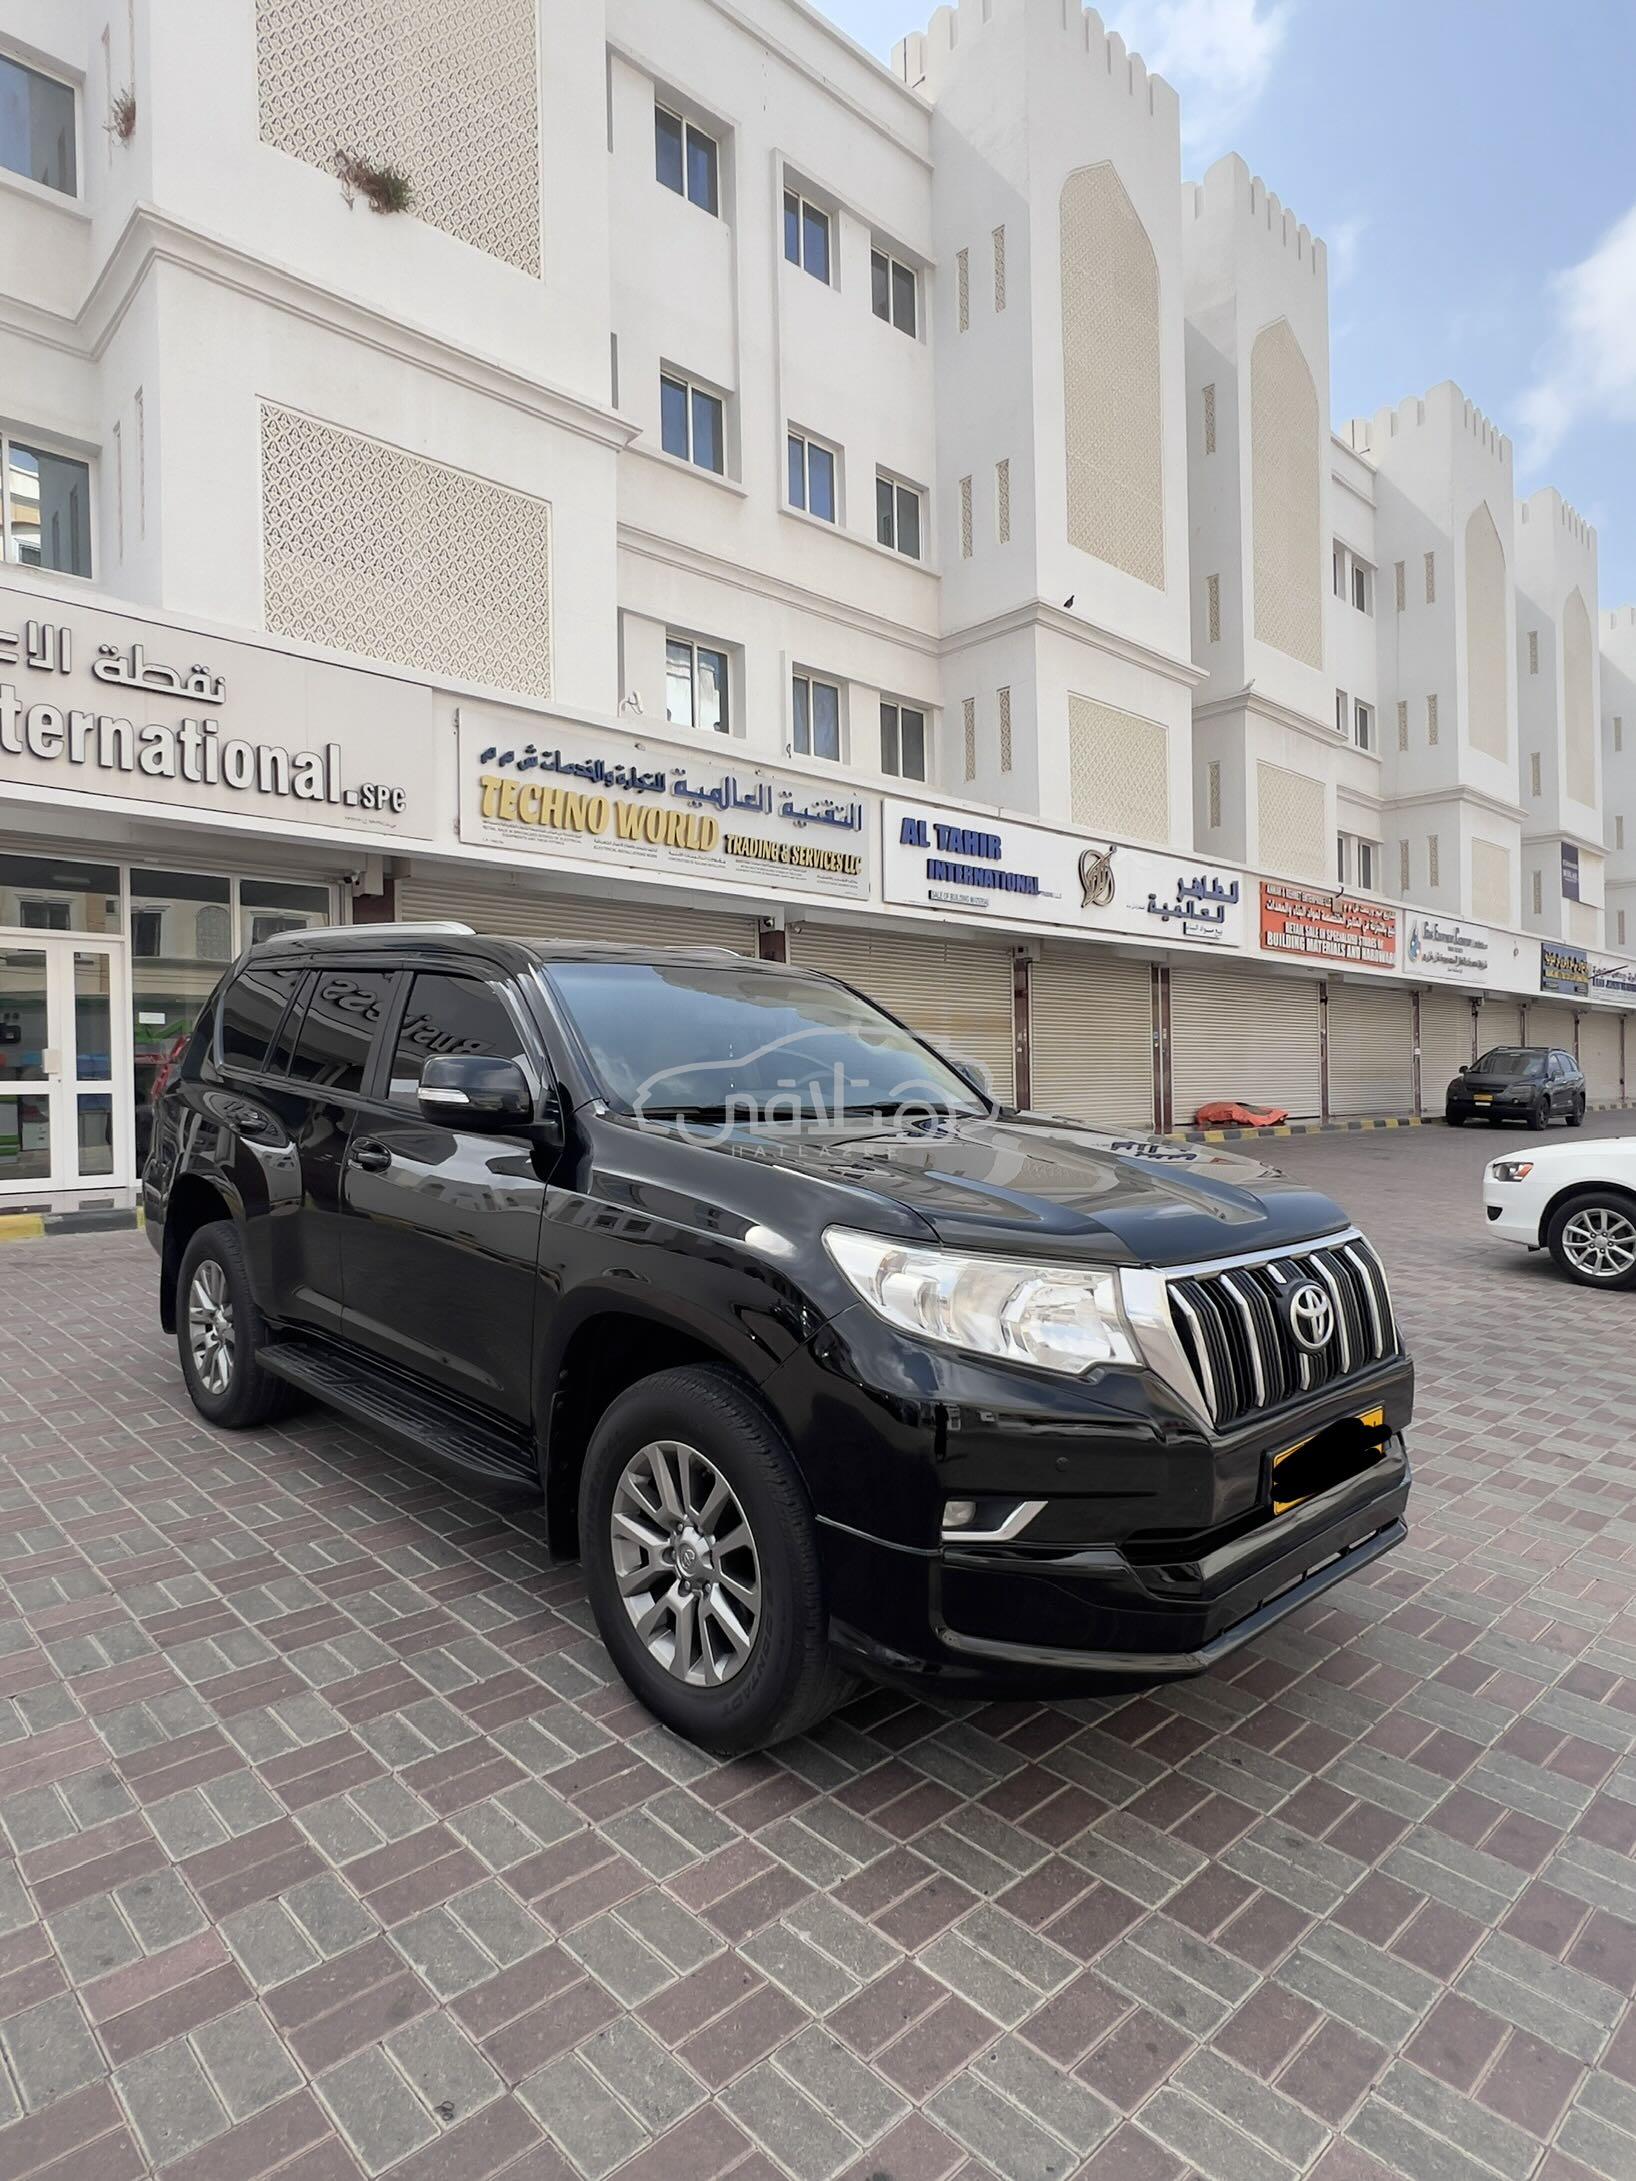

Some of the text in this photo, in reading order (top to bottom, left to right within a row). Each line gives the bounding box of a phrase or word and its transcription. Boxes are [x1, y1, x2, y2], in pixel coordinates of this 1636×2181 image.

[92, 643, 226, 705] نقطة
[671, 768, 772, 815] العالمية
[779, 791, 862, 832] التقنية
[479, 775, 610, 835] TECHNO
[614, 800, 720, 853] WORLD
[724, 834, 780, 862] TRADING
[780, 844, 790, 864] &
[791, 846, 844, 873] SERVICES
[844, 855, 862, 876] LLC
[900, 817, 1002, 859] AL TAHIR
[927, 859, 1040, 896] INTERNATIONAL
[1266, 931, 1305, 951] BUILDING
[1305, 938, 1346, 957] MATERIALS
